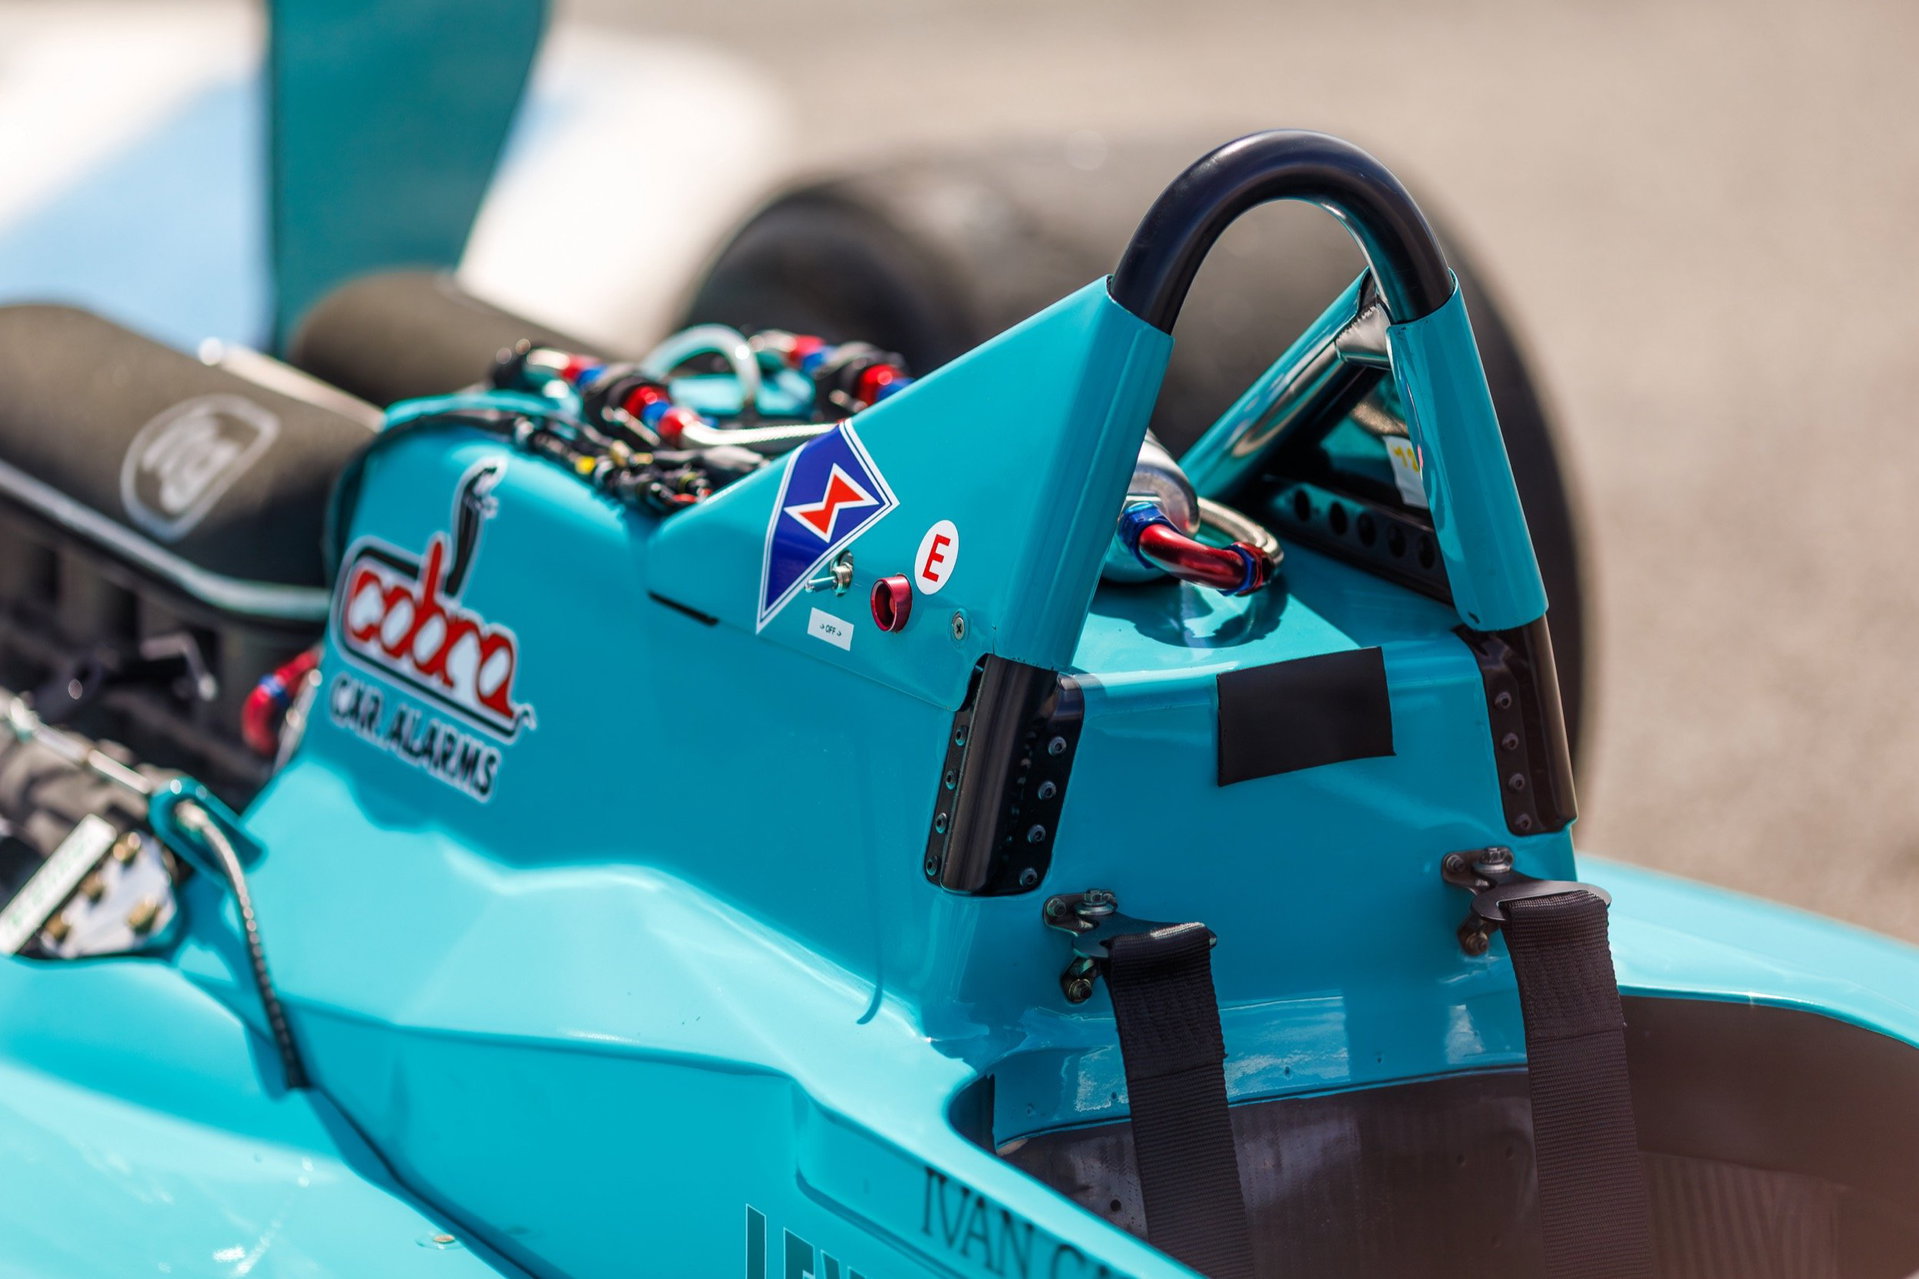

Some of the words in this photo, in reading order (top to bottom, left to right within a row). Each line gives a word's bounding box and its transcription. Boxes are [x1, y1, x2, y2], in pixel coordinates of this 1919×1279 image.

[922, 533, 952, 583] E
[825, 624, 837, 635] OFF
[332, 677, 382, 734] CAR
[388, 709, 497, 796] ALARMS
[922, 1166, 1036, 1279] IVAN
